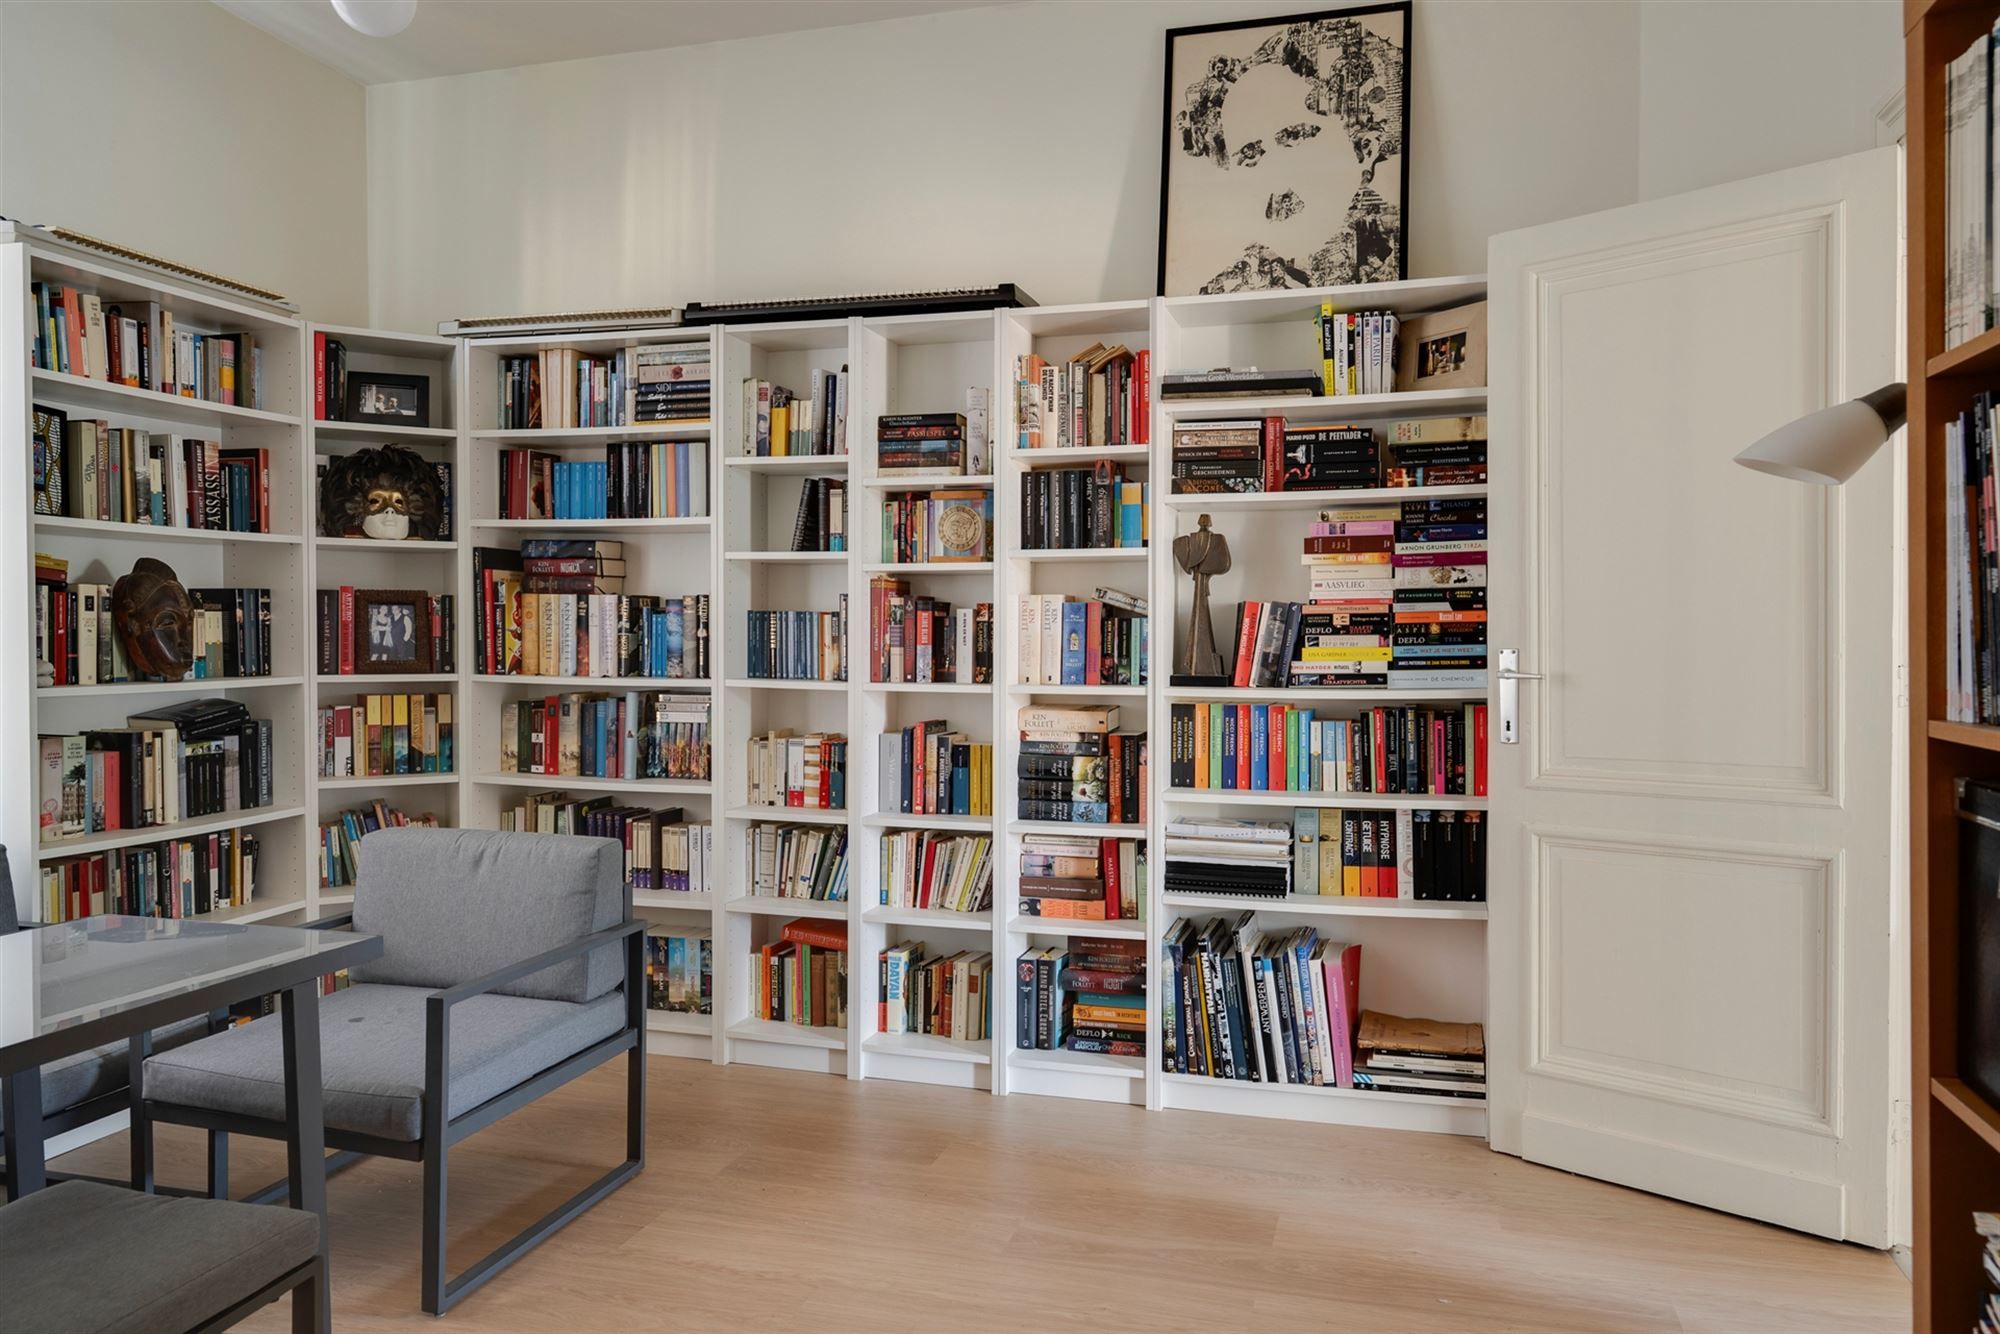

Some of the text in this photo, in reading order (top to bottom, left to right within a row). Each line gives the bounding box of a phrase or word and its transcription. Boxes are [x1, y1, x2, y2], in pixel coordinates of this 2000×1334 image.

[1318, 432, 1327, 441] DE
[1329, 431, 1362, 440] PEETVADER
[1430, 513, 1457, 522] Chocolat
[532, 566, 555, 574] FOLLETT
[1326, 581, 1365, 589] AASVLIEG
[1024, 720, 1054, 728] FOLLETT
[1344, 820, 1354, 857] CONTRACT
[1362, 820, 1372, 852] GETUIGE
[1380, 820, 1390, 860] HYPNOSE
[889, 961, 899, 1000] DAYAN
[1072, 981, 1096, 989] FOLLETT
[1200, 952, 1215, 1015] MANHATTAN
[1040, 965, 1048, 1040] GRAND HOTEL EUROPA
[1256, 981, 1272, 1034] ANTWERPEN
[1076, 1029, 1100, 1037] DEFLO
